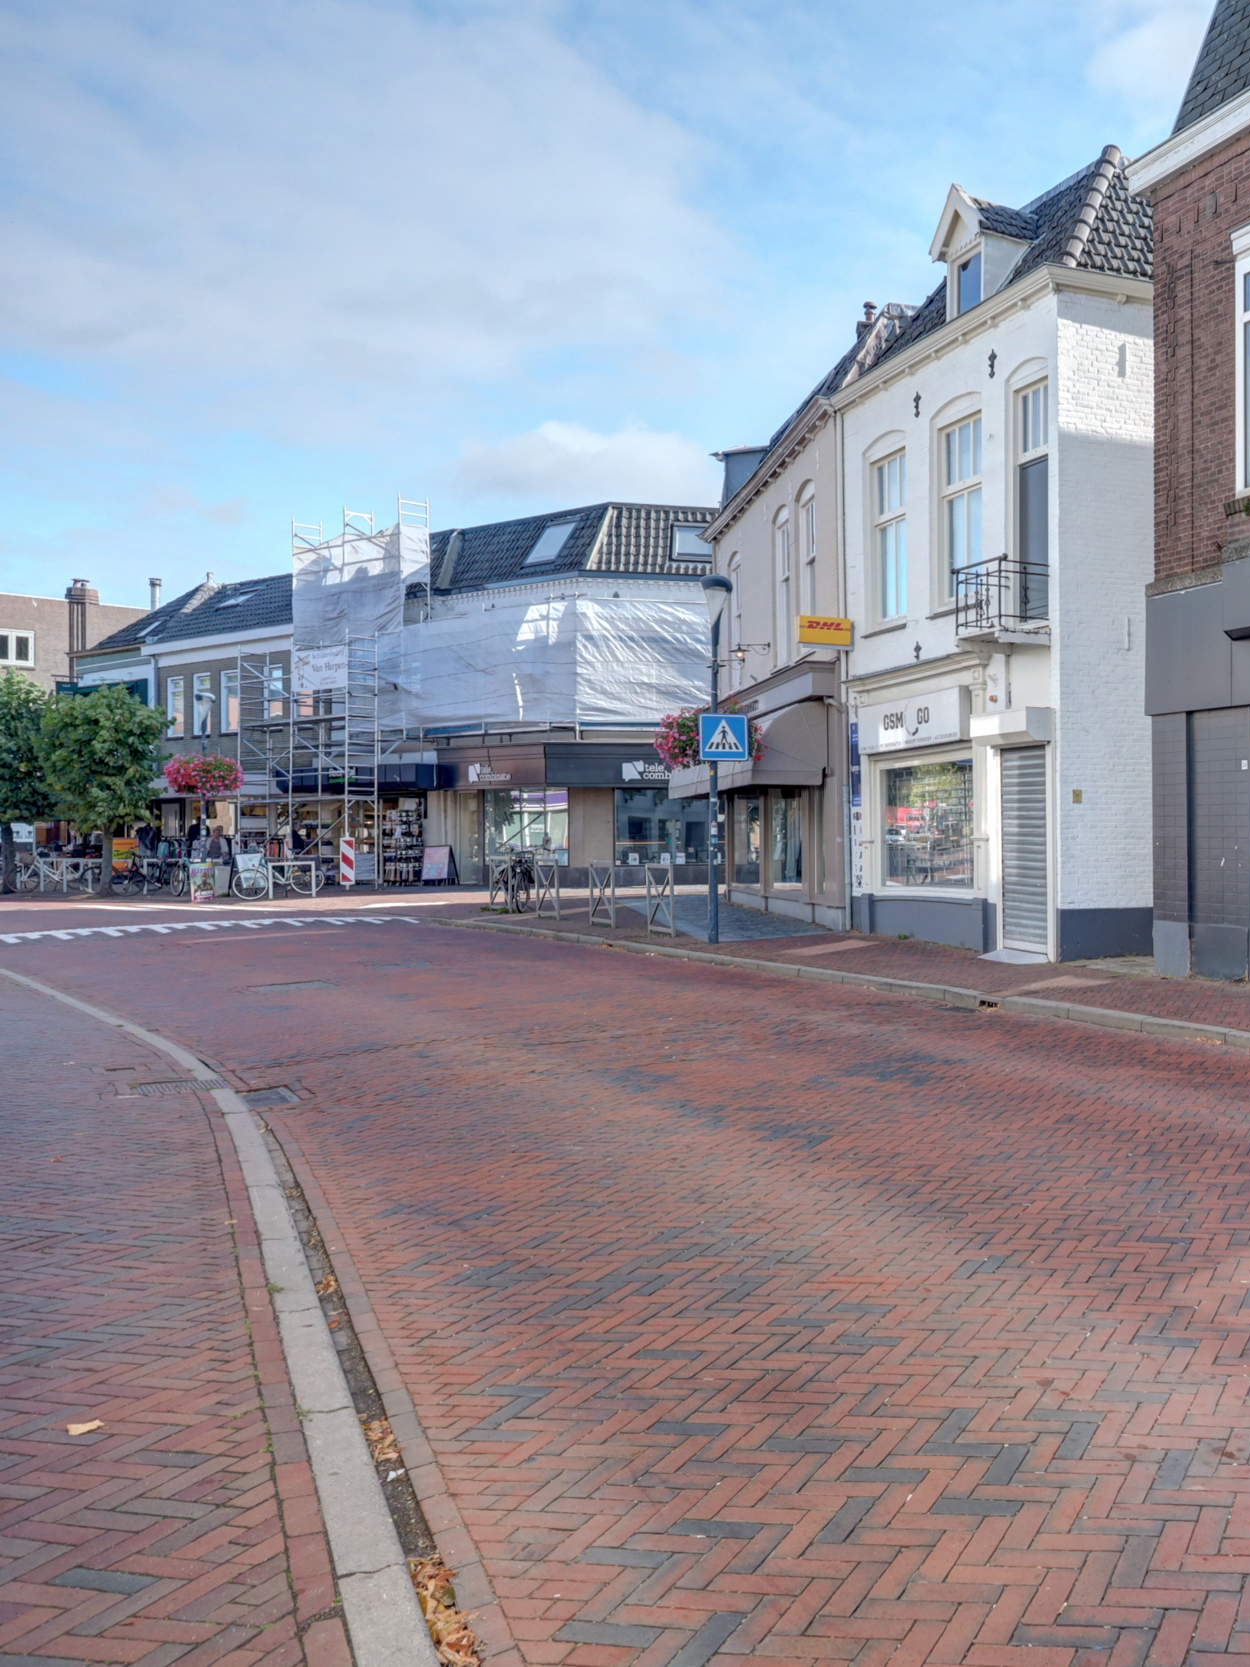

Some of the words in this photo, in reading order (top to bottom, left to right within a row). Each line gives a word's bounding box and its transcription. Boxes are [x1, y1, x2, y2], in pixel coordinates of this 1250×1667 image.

[806, 620, 843, 631] DHL
[311, 664, 323, 672] Van
[883, 711, 904, 731] GSM
[916, 706, 930, 725] GO
[480, 764, 492, 774] tele
[645, 763, 664, 772] tele
